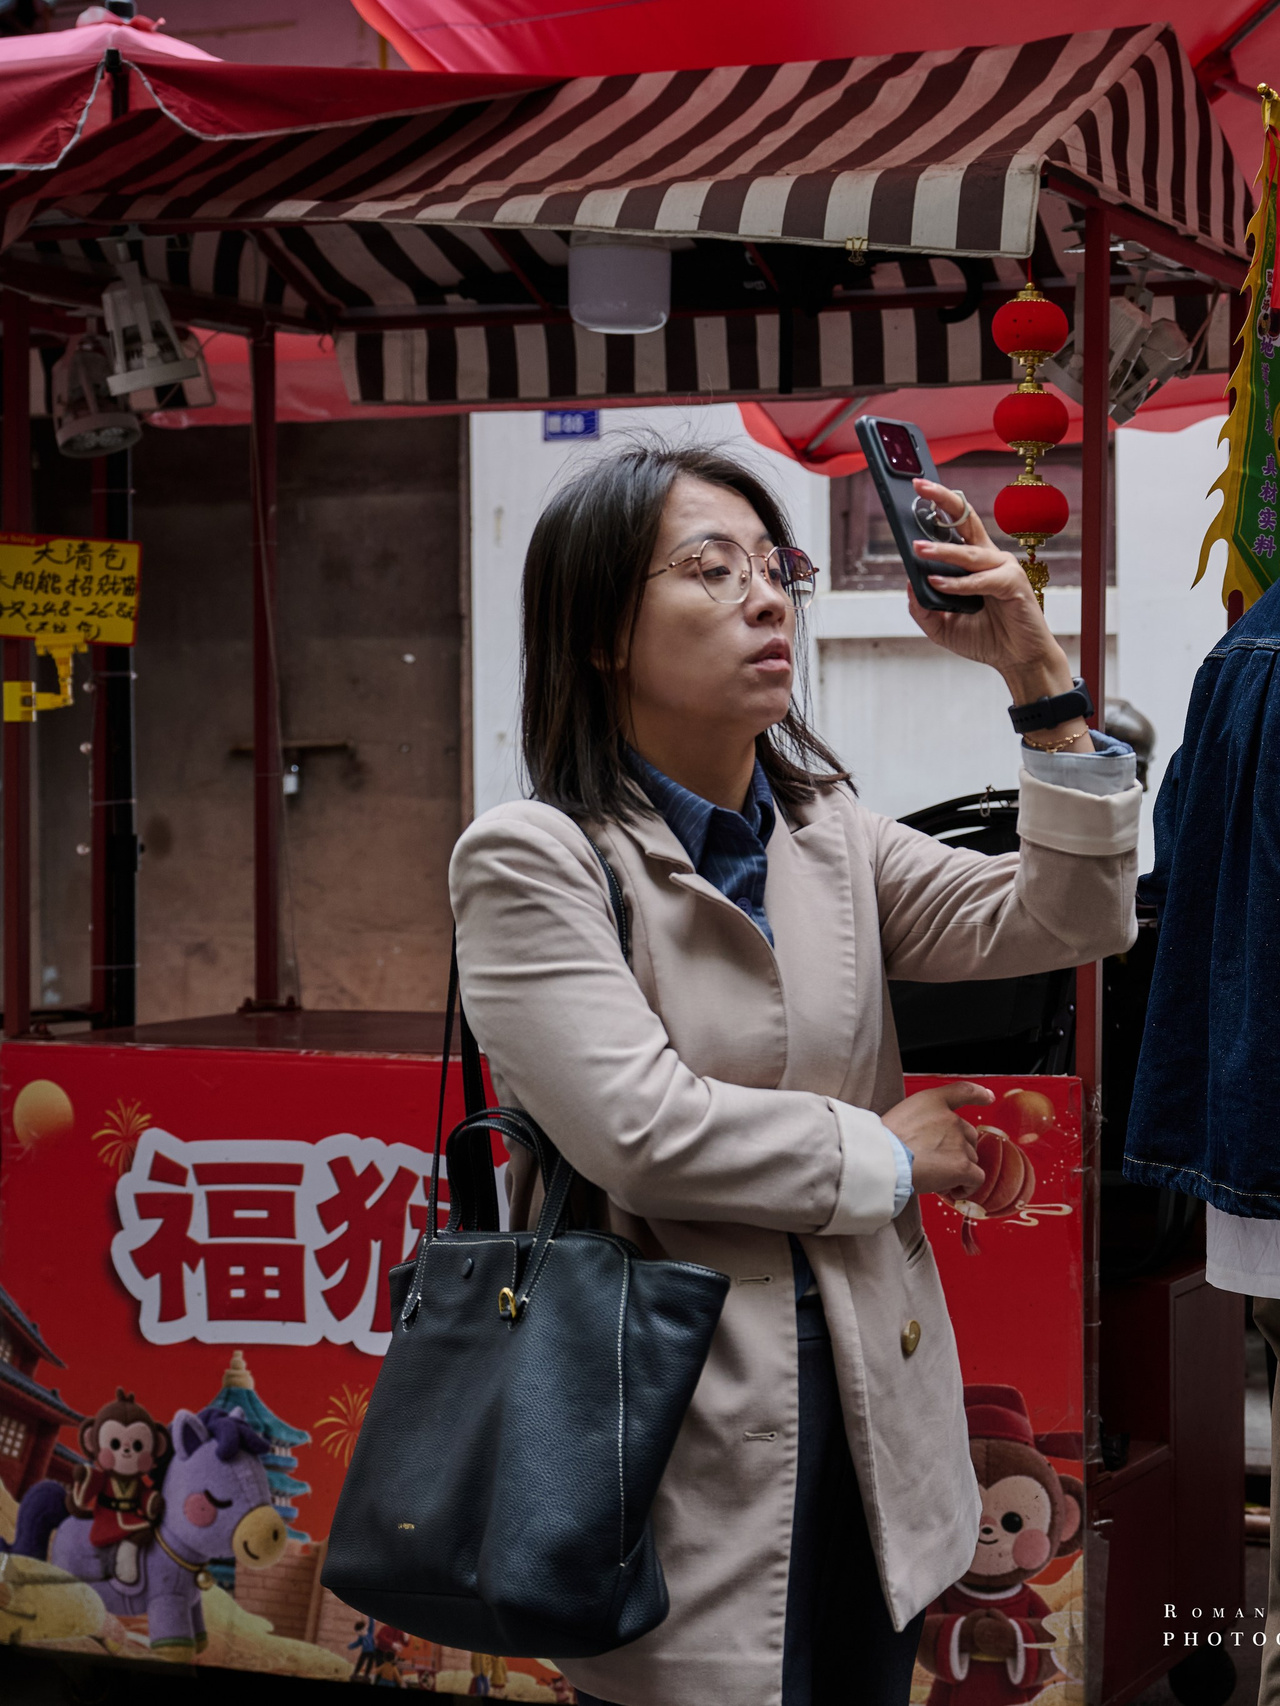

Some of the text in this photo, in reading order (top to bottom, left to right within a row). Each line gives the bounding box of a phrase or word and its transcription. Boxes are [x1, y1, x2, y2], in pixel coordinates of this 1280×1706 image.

[1254, 453, 1279, 559] 真材实料
[33, 542, 126, 572] 大清仓
